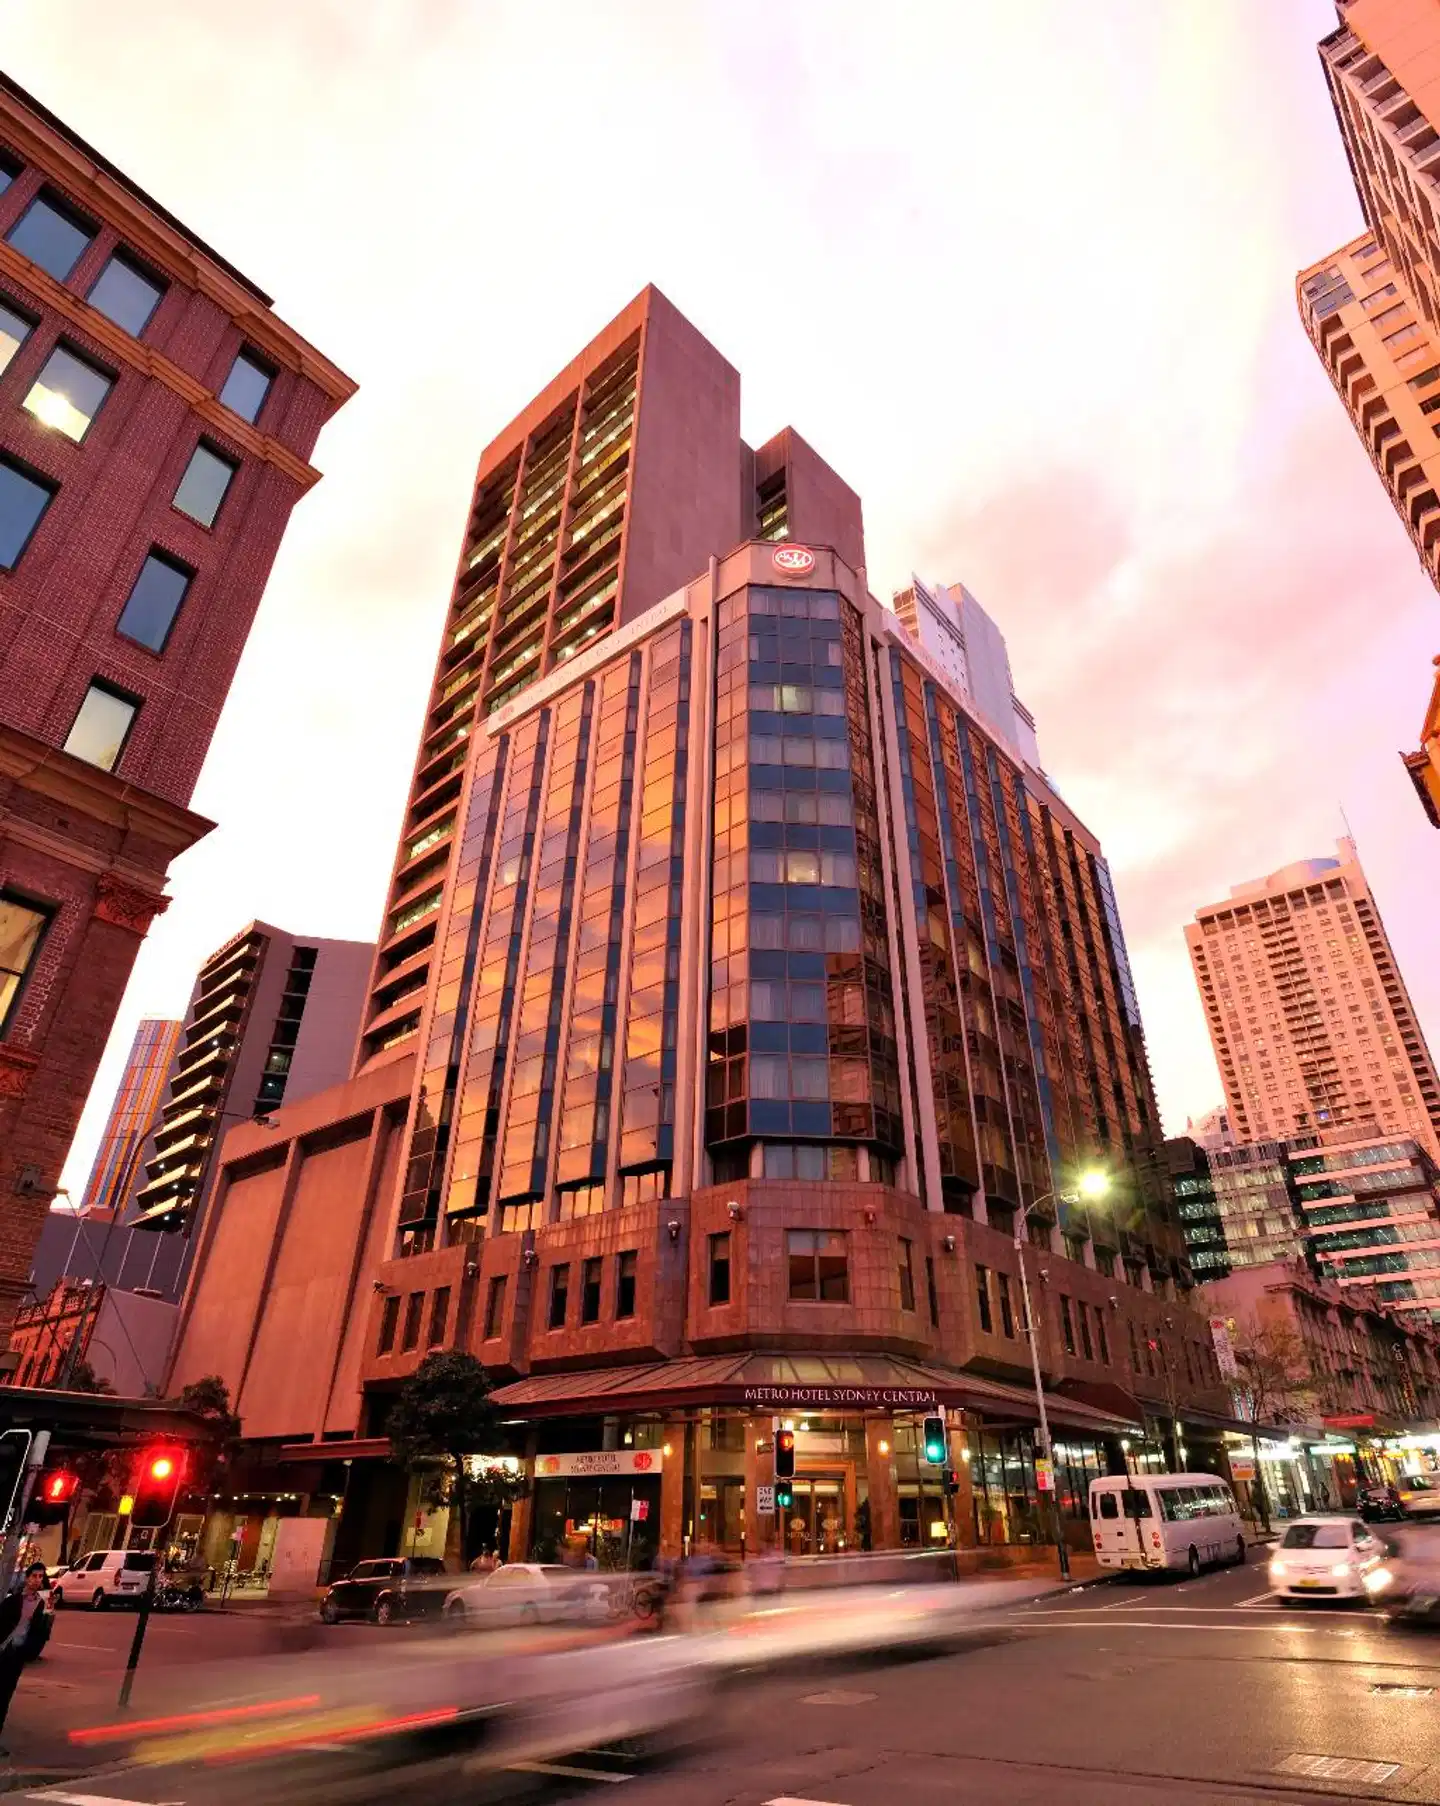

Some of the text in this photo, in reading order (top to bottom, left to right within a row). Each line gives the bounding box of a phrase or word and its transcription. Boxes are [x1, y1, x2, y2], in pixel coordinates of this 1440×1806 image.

[745, 1387, 936, 1403] METRO HOTEL SYDNEY CENTRAL
[759, 1487, 771, 1495] ONE
